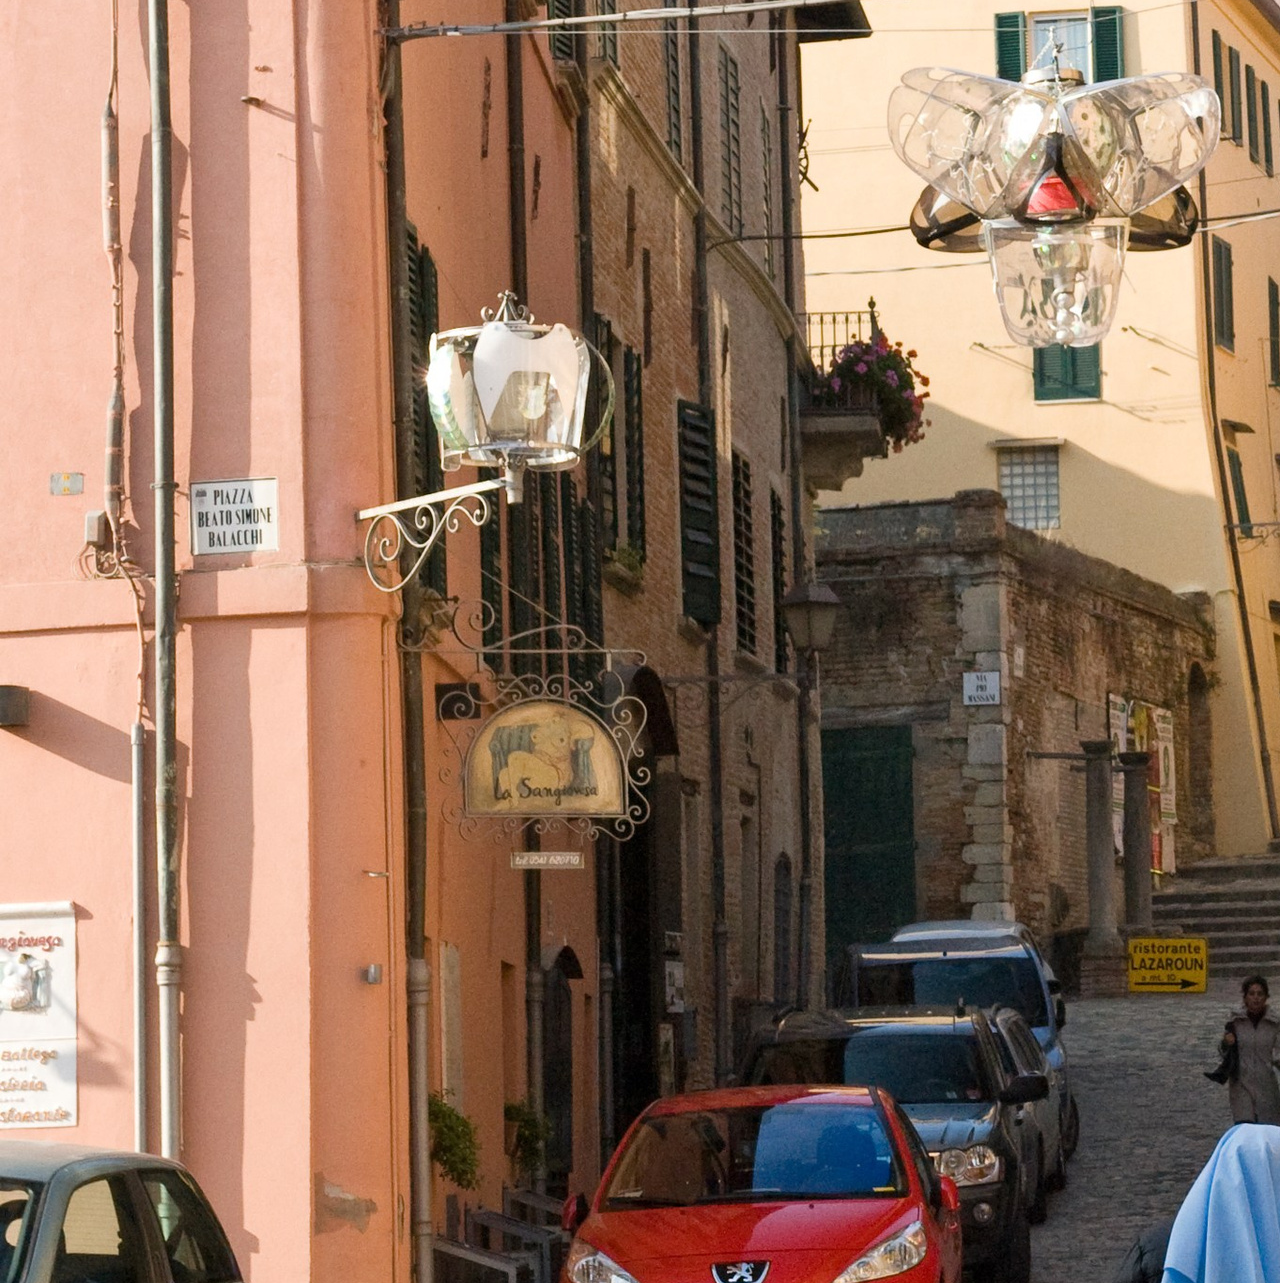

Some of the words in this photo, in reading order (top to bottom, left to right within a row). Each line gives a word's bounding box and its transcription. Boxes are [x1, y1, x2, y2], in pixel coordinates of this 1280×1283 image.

[213, 488, 253, 506] PIAZZA
[197, 510, 232, 528] BEATO
[235, 507, 272, 525] SIMONE
[208, 529, 263, 548] BALACCHI
[494, 776, 512, 800] La
[1133, 943, 1201, 954] ristorante
[1131, 957, 1204, 971] LAZAROUN
